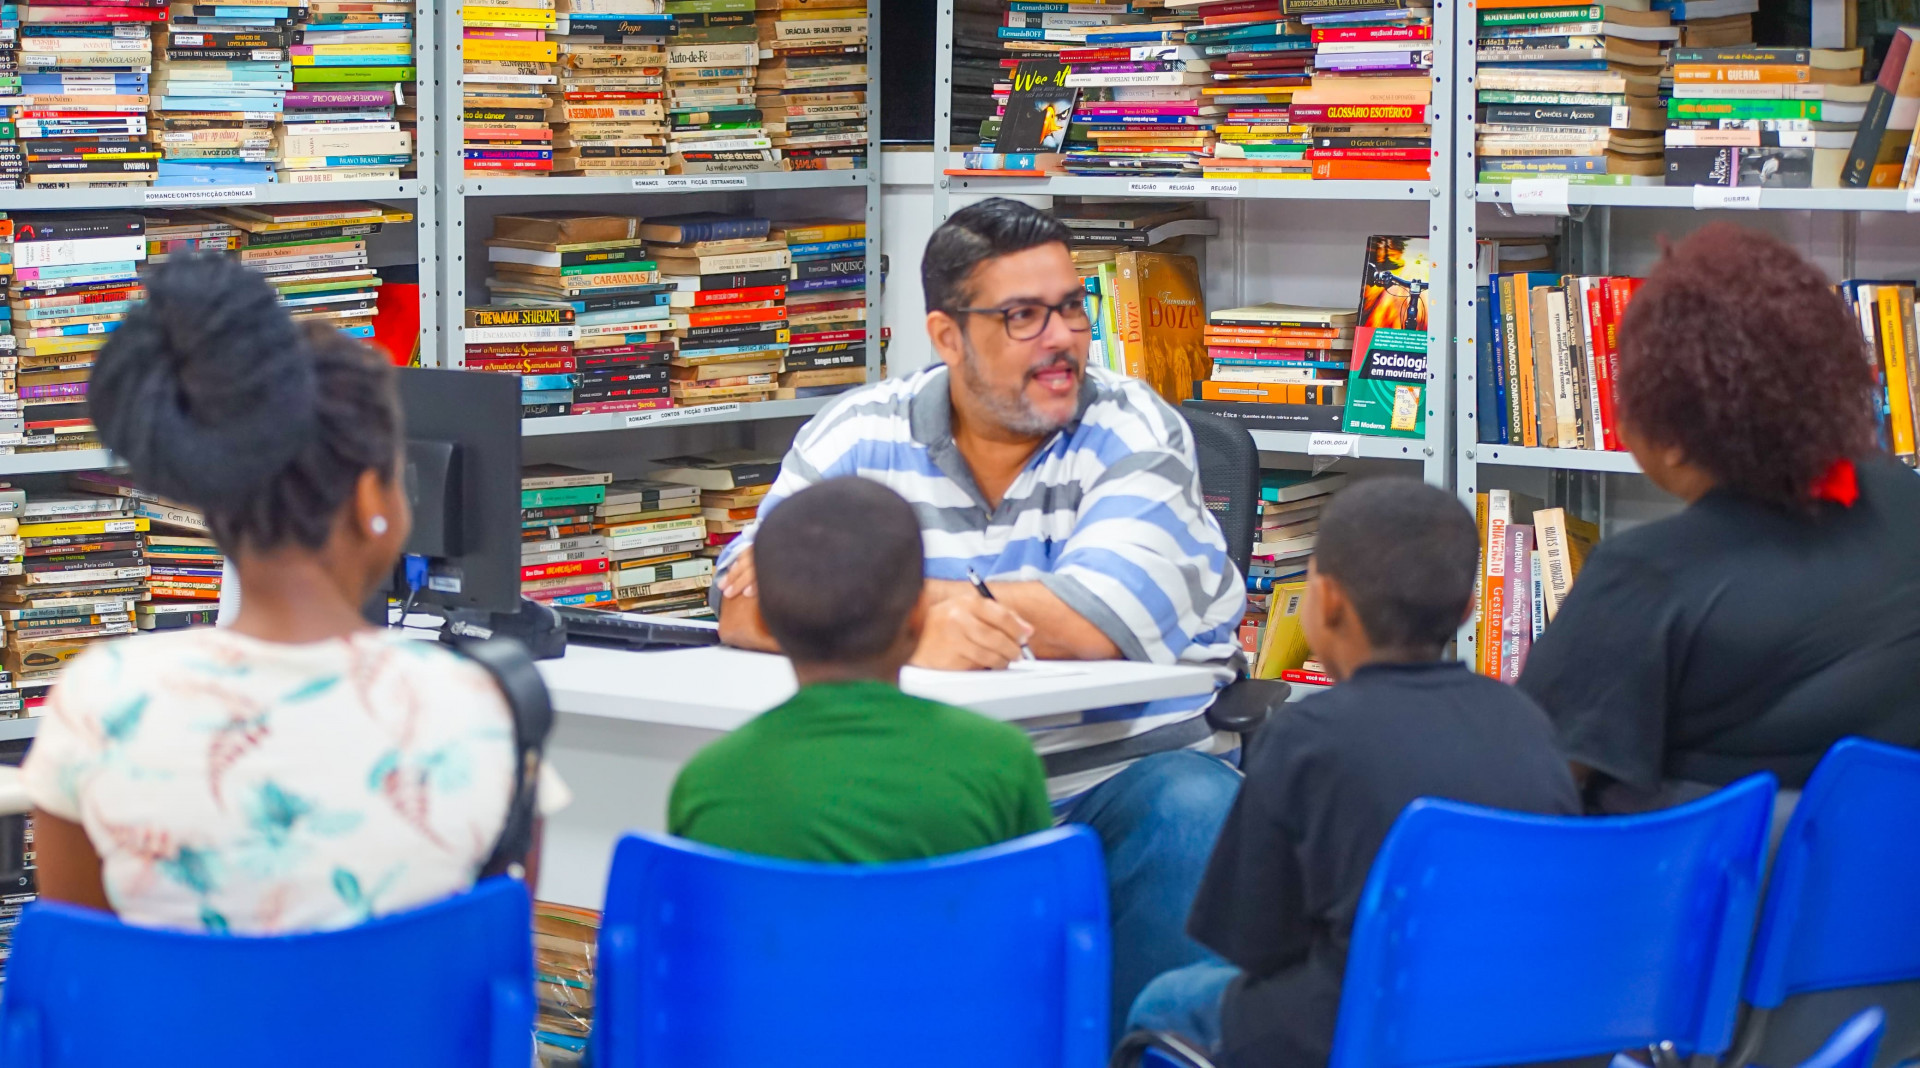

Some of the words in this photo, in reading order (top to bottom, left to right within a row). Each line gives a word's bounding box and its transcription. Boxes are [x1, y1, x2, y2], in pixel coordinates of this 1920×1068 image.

[617, 21, 642, 34] Praga
[785, 27, 811, 35] DRÁCULA
[831, 25, 852, 33] STOKER
[669, 50, 708, 64] Auto-de-Fé
[1727, 69, 1760, 81] GUERRA
[1514, 95, 1559, 104] SOLDADOS
[598, 108, 615, 118] DAMA
[1327, 105, 1369, 119] GLOSSÁRIO
[1370, 106, 1412, 118] ESOTÉRICO
[1534, 108, 1562, 119] CANHÕES
[1569, 108, 1595, 119] AGOSTO
[1131, 183, 1157, 191] RELIGIÃO
[1723, 195, 1750, 203] GUERRA
[831, 260, 866, 274] INQUISIÇ
[593, 273, 646, 285] CARAVANAS
[1503, 281, 1513, 321] SISTEMAS
[480, 312, 519, 325] TREVANIAN
[522, 310, 560, 324] SHIBUMI
[1606, 323, 1617, 349] Heath
[488, 344, 511, 354] Amuleto
[511, 345, 520, 353] de
[520, 343, 558, 357] Samarkand
[1507, 321, 1518, 376] ECONÔMICOS
[44, 354, 77, 364] FLAGELO
[489, 361, 512, 371] Amuleto
[513, 361, 522, 370] de
[523, 359, 561, 373] Samarkand
[1385, 369, 1426, 381] moviment
[1510, 376, 1521, 434] COMPARADOS
[628, 415, 652, 423] ROMANCE
[1360, 422, 1386, 430] Moderna
[1312, 439, 1349, 447] SOCIOLOGIA
[167, 511, 184, 522] Cem
[1491, 518, 1505, 577] CHIAVENATO
[1513, 531, 1523, 573] CHIAVENATO
[618, 588, 629, 599] KEN
[630, 585, 651, 597] FOLLETT
[1492, 587, 1504, 627] Gestão
[1511, 578, 1522, 624] ADMINISTRAÇÃO
[1511, 623, 1520, 635] NOS
[1510, 636, 1520, 655] NOVOS
[1490, 640, 1501, 675] Pessoas
[1510, 655, 1520, 678] TEMPOS
